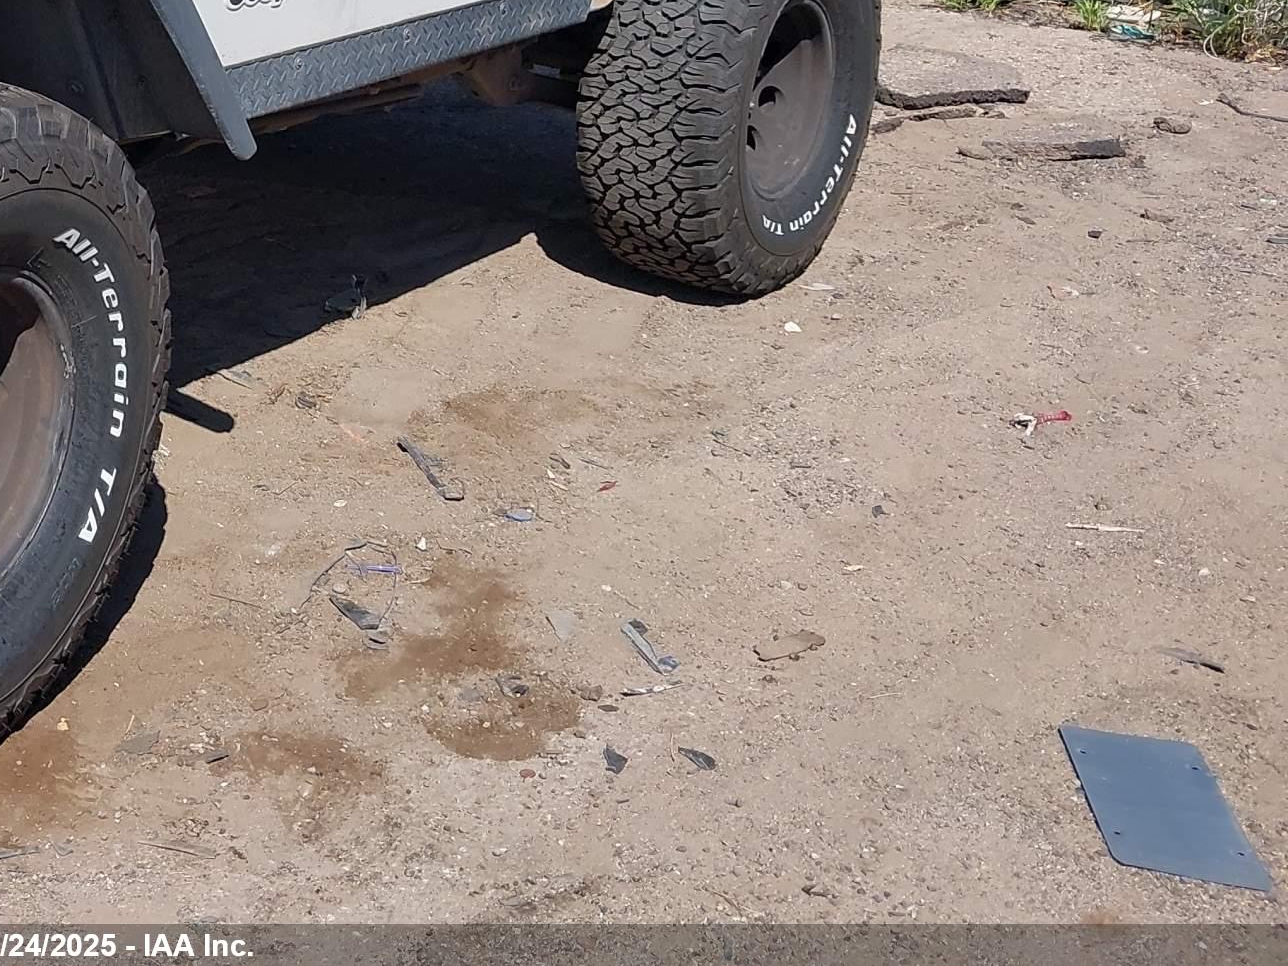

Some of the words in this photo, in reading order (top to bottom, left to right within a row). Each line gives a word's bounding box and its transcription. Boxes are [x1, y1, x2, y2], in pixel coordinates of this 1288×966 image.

[789, 114, 857, 232] All-Terrain
[52, 228, 129, 438] All-Terrain
[78, 467, 117, 543] T/A
